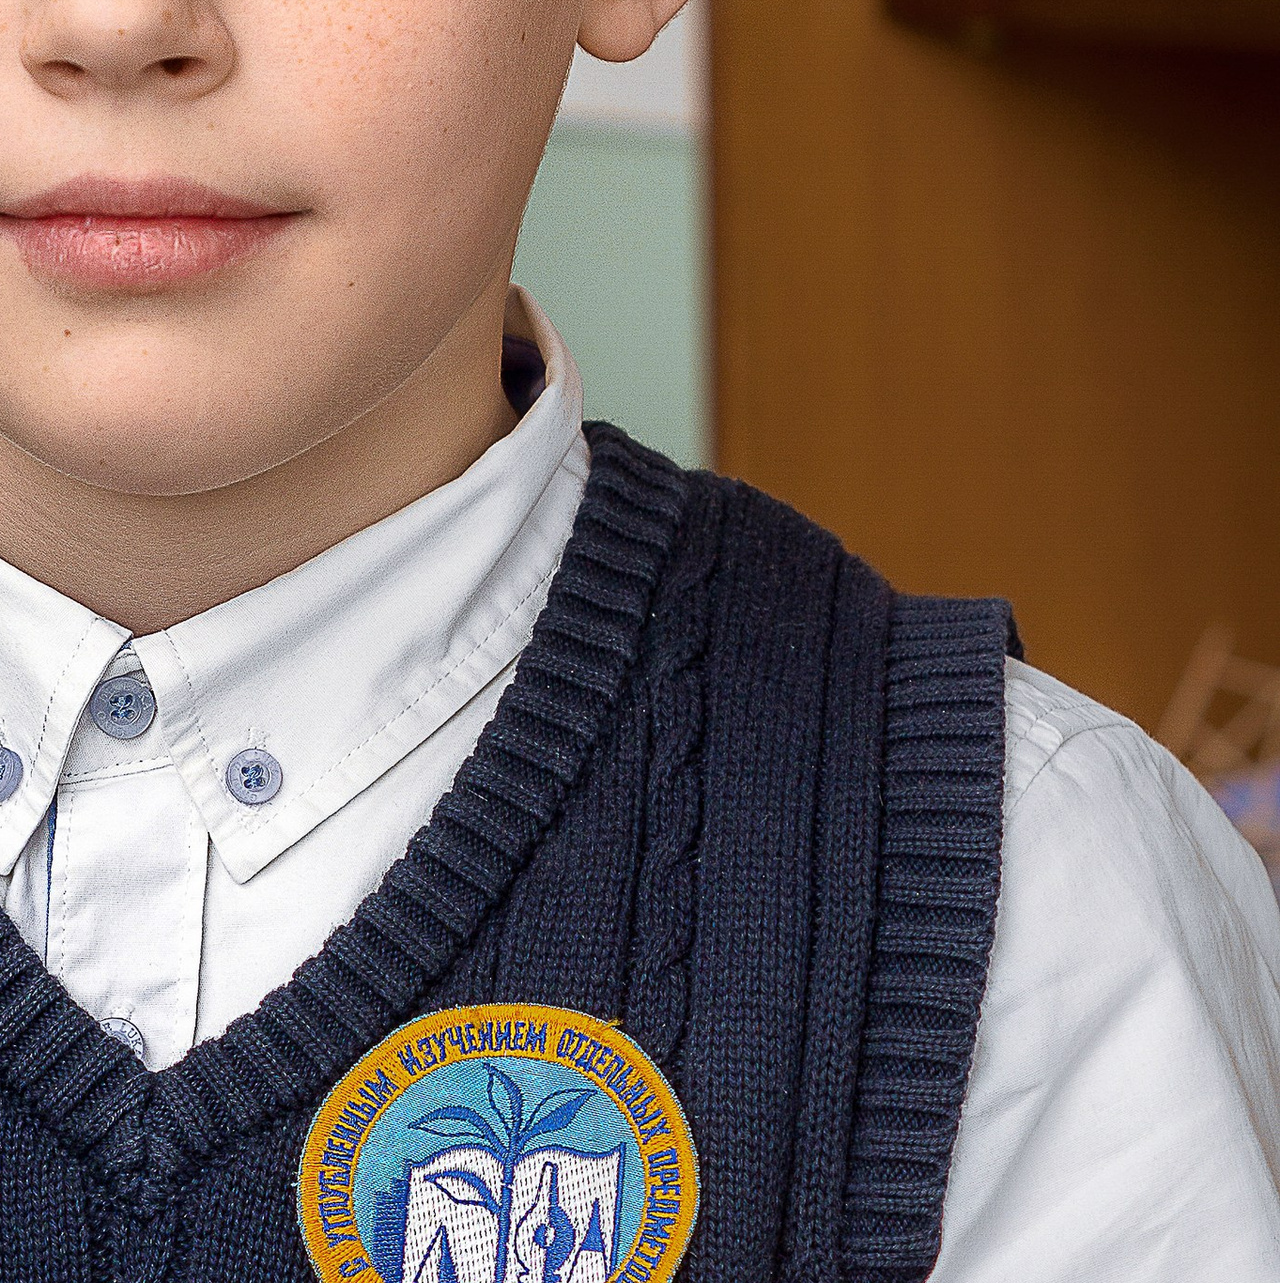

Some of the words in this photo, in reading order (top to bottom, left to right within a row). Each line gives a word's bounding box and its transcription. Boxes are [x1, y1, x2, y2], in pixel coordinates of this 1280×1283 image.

[337, 1256, 370, 1279] С
[397, 1020, 548, 1076] ИЗУЧЕНИЕМ
[556, 1028, 670, 1145] ОТДЕЛЬНЫХ
